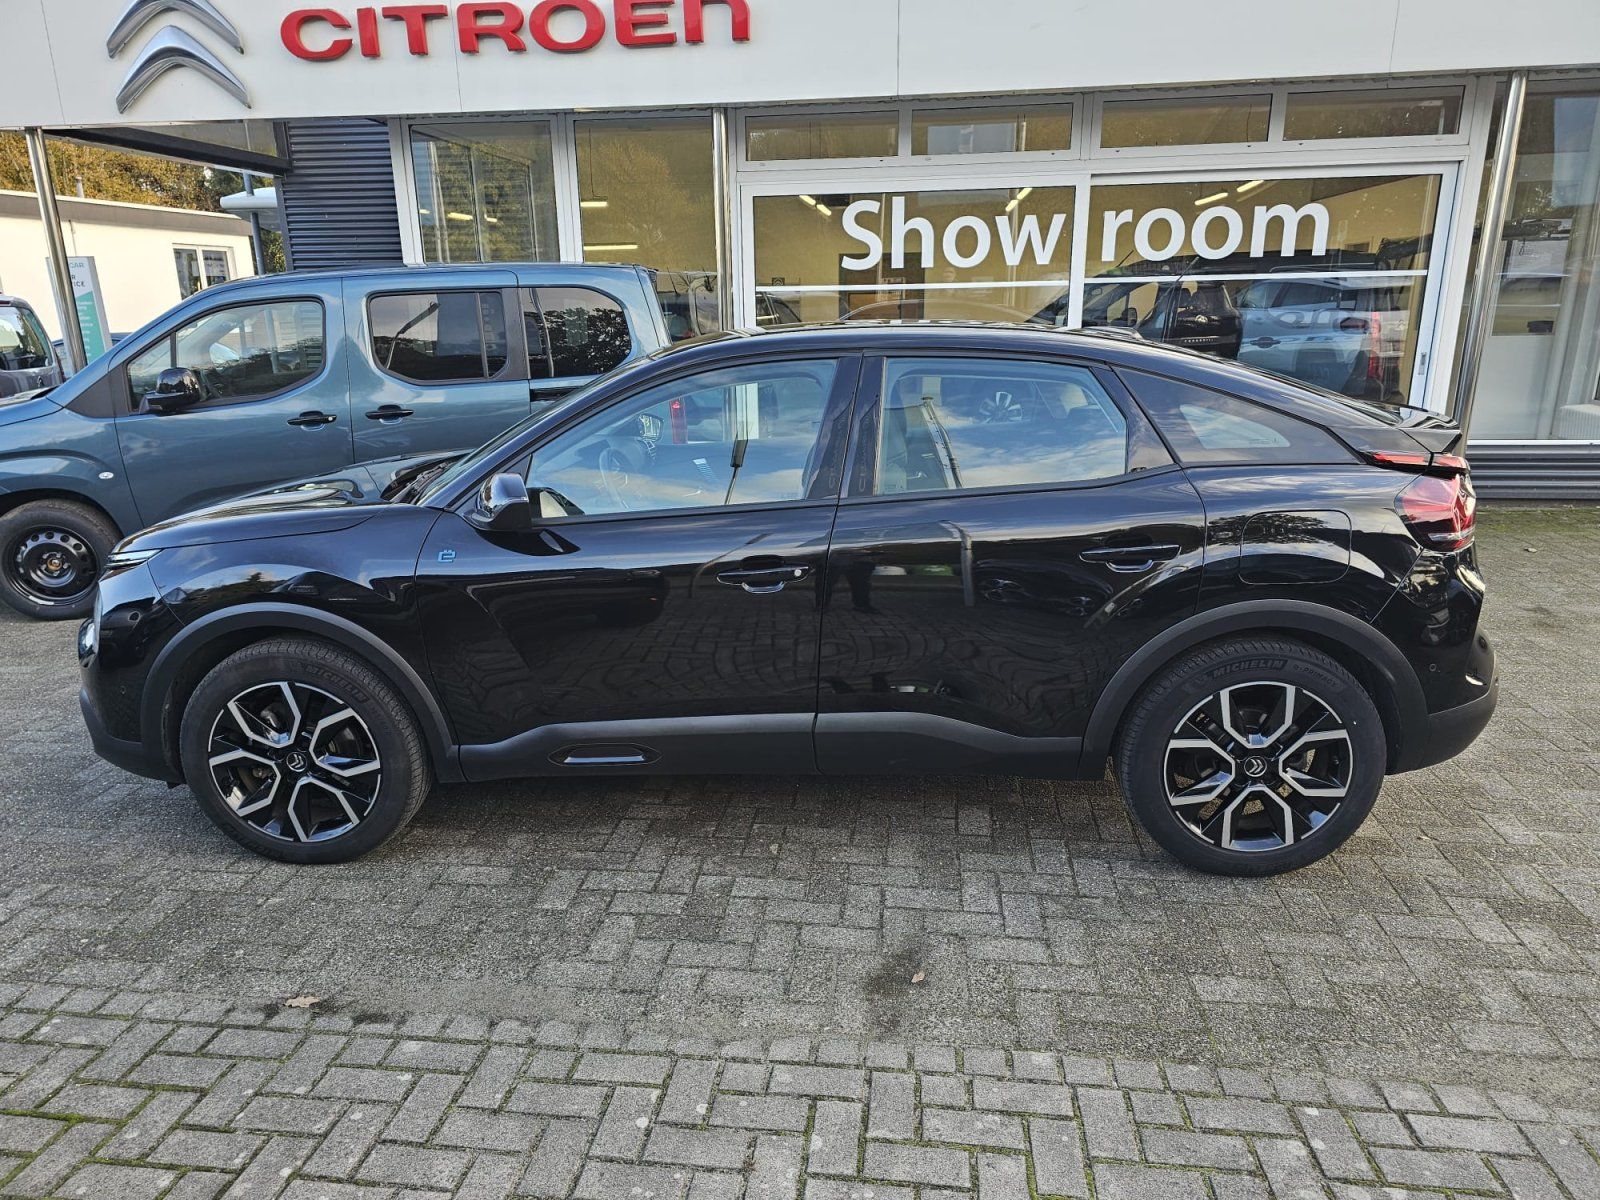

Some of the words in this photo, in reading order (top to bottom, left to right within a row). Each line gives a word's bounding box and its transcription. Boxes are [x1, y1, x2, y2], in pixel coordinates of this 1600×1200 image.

[841, 196, 1066, 271] Show
[1101, 202, 1329, 262] room
[1212, 660, 1285, 679] MICHELIN
